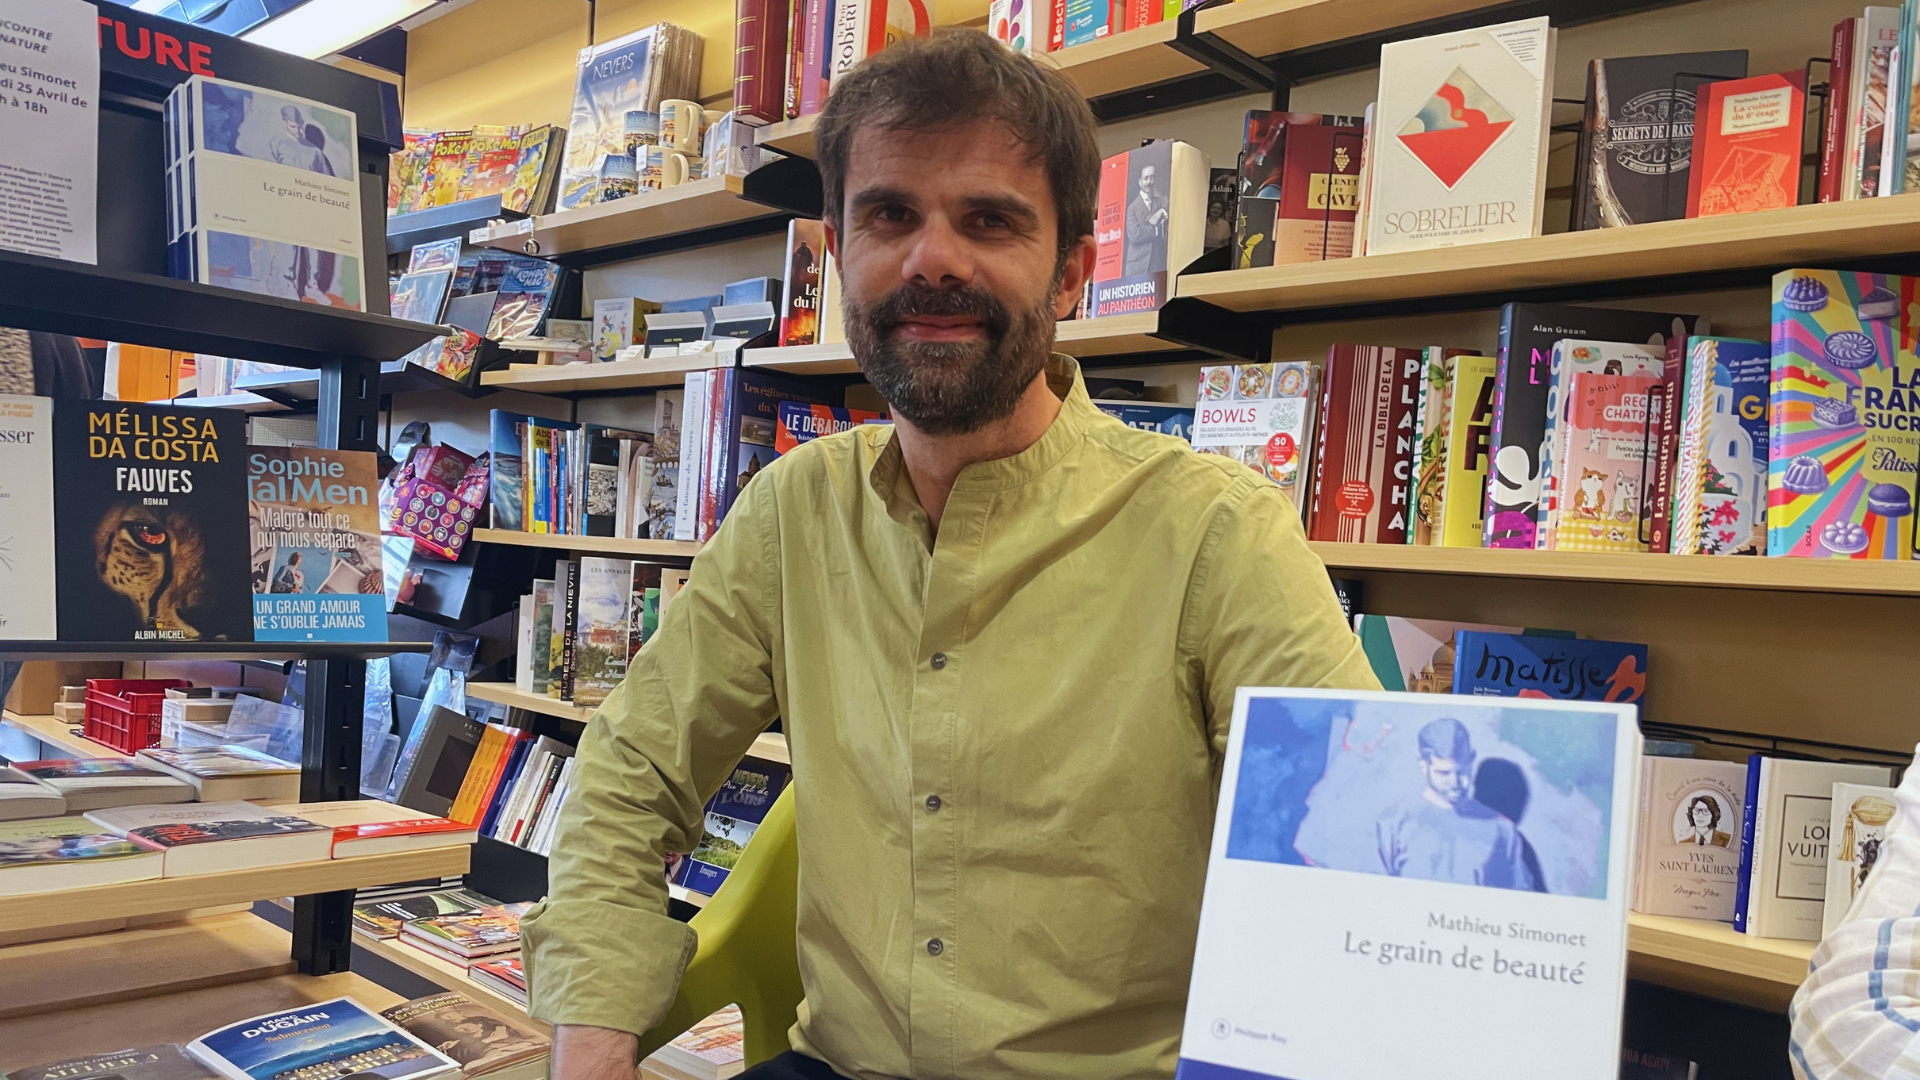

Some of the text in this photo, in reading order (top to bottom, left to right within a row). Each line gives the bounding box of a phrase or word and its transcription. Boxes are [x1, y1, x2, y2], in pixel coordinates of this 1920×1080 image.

[808, 14, 818, 66] Architecture de
[593, 52, 634, 80] NEVERS
[20, 66, 77, 90] Simonet
[17, 82, 32, 94] 25
[36, 87, 68, 104] Avril
[71, 96, 88, 108] de
[11, 96, 48, 114] à 18h
[1733, 100, 1780, 113] La cuisine
[1732, 108, 1780, 122] du étage
[1612, 126, 1664, 141] SECRETS DE
[264, 182, 350, 210] Le grain de beauté
[1384, 200, 1516, 235] SOBRELIER
[516, 268, 546, 282] KOMBO
[524, 276, 544, 287] MAG
[1100, 280, 1155, 302] UN HISTORIEN
[794, 296, 808, 308] du
[1098, 296, 1156, 316] AU PANTHÉON
[1532, 324, 1586, 335] Alan Geaam
[743, 383, 788, 398] Les églises
[1376, 360, 1393, 448] LA BIBLE DE LA
[89, 408, 218, 440] MÉLISSA
[786, 413, 800, 432] LE
[1202, 408, 1256, 424] BOWLS
[1274, 437, 1286, 446] 50
[1434, 364, 1454, 503] AIRFRYER
[89, 436, 220, 462] DA COSTA
[1388, 359, 1420, 531] PLANCHA
[1654, 382, 1674, 518] La nostra pasta
[1776, 442, 1782, 456] LA
[250, 453, 344, 480] Sophie
[682, 430, 694, 521] La faïence de Nevers
[116, 467, 193, 494] FAUVES
[143, 497, 168, 506] ROMAN
[260, 507, 350, 530] Malgré tout ce
[257, 526, 355, 550] qui nous sépare
[256, 600, 360, 614] UN GRAND AMOUR
[254, 615, 366, 630] NE S'OUBLIE JAMAIS
[566, 612, 572, 626] LA
[134, 630, 186, 640] ALBIN MICHEL
[566, 630, 572, 646] DE
[724, 780, 769, 796] Au fil de
[1659, 860, 1690, 871] SAINT
[1688, 852, 1714, 863] YVES
[700, 864, 718, 878] Images
[1428, 912, 1586, 948] Mathieu Simonet
[1344, 931, 1585, 985] Le grain de beauté
[388, 1007, 409, 1018] Les
[411, 994, 462, 1008] orphelins
[422, 996, 470, 1010] Vuillard
[242, 1012, 330, 1038] DUGAIN
[262, 1014, 298, 1026] MARC
[264, 1022, 332, 1042] Submersion
